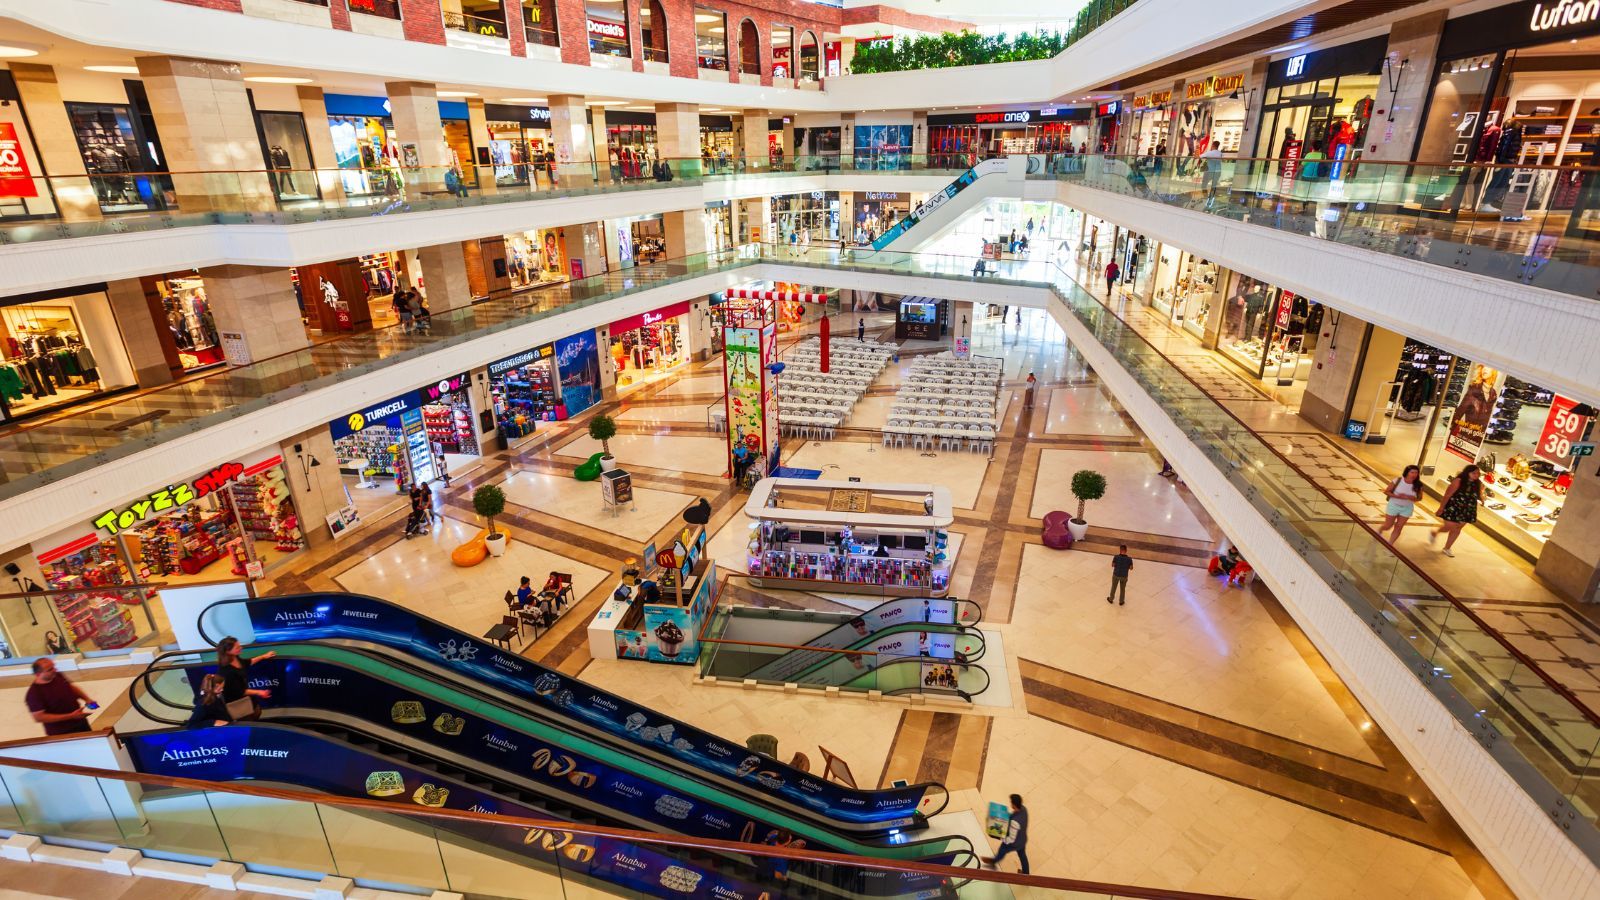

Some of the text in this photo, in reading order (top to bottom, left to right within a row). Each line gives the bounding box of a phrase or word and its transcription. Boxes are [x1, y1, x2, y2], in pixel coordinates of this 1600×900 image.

[1530, 0, 1600, 31] Lufian
[587, 20, 625, 37] Donald's
[773, 48, 789, 58] KFC
[1286, 54, 1307, 77] LOFT
[1281, 296, 1291, 309] 50
[1279, 311, 1288, 324] 30
[365, 400, 408, 422] TURKCELL
[1554, 409, 1579, 433] 50
[1544, 434, 1569, 458] 30
[342, 610, 379, 619] JEWELLERY
[299, 676, 341, 686] JEWELLERY
[241, 748, 289, 758] JEWELLERY
